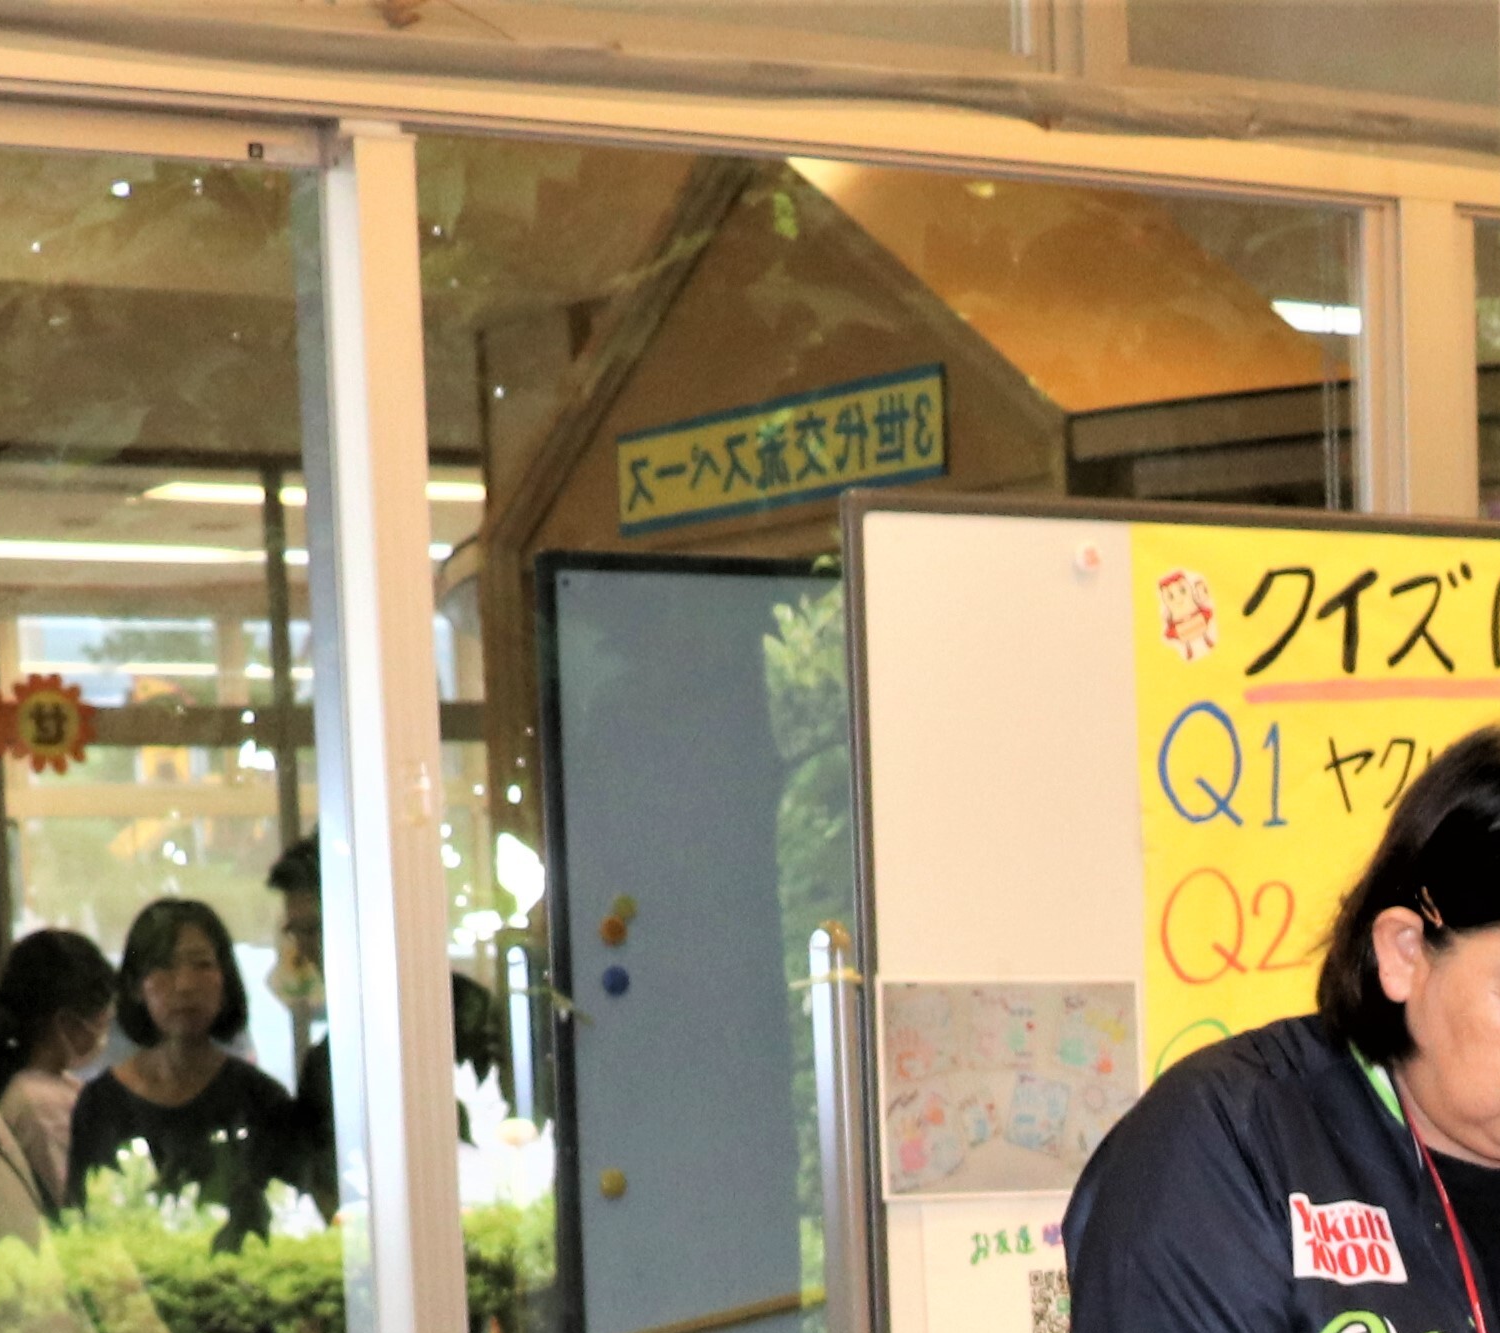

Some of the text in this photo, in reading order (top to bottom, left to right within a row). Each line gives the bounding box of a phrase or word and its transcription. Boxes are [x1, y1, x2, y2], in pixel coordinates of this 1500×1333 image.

[1157, 699, 1288, 827] Q1
[1324, 736, 1434, 814] ヤク
[1160, 867, 1296, 985] Q2
[1306, 1237, 1391, 1278] 1000
